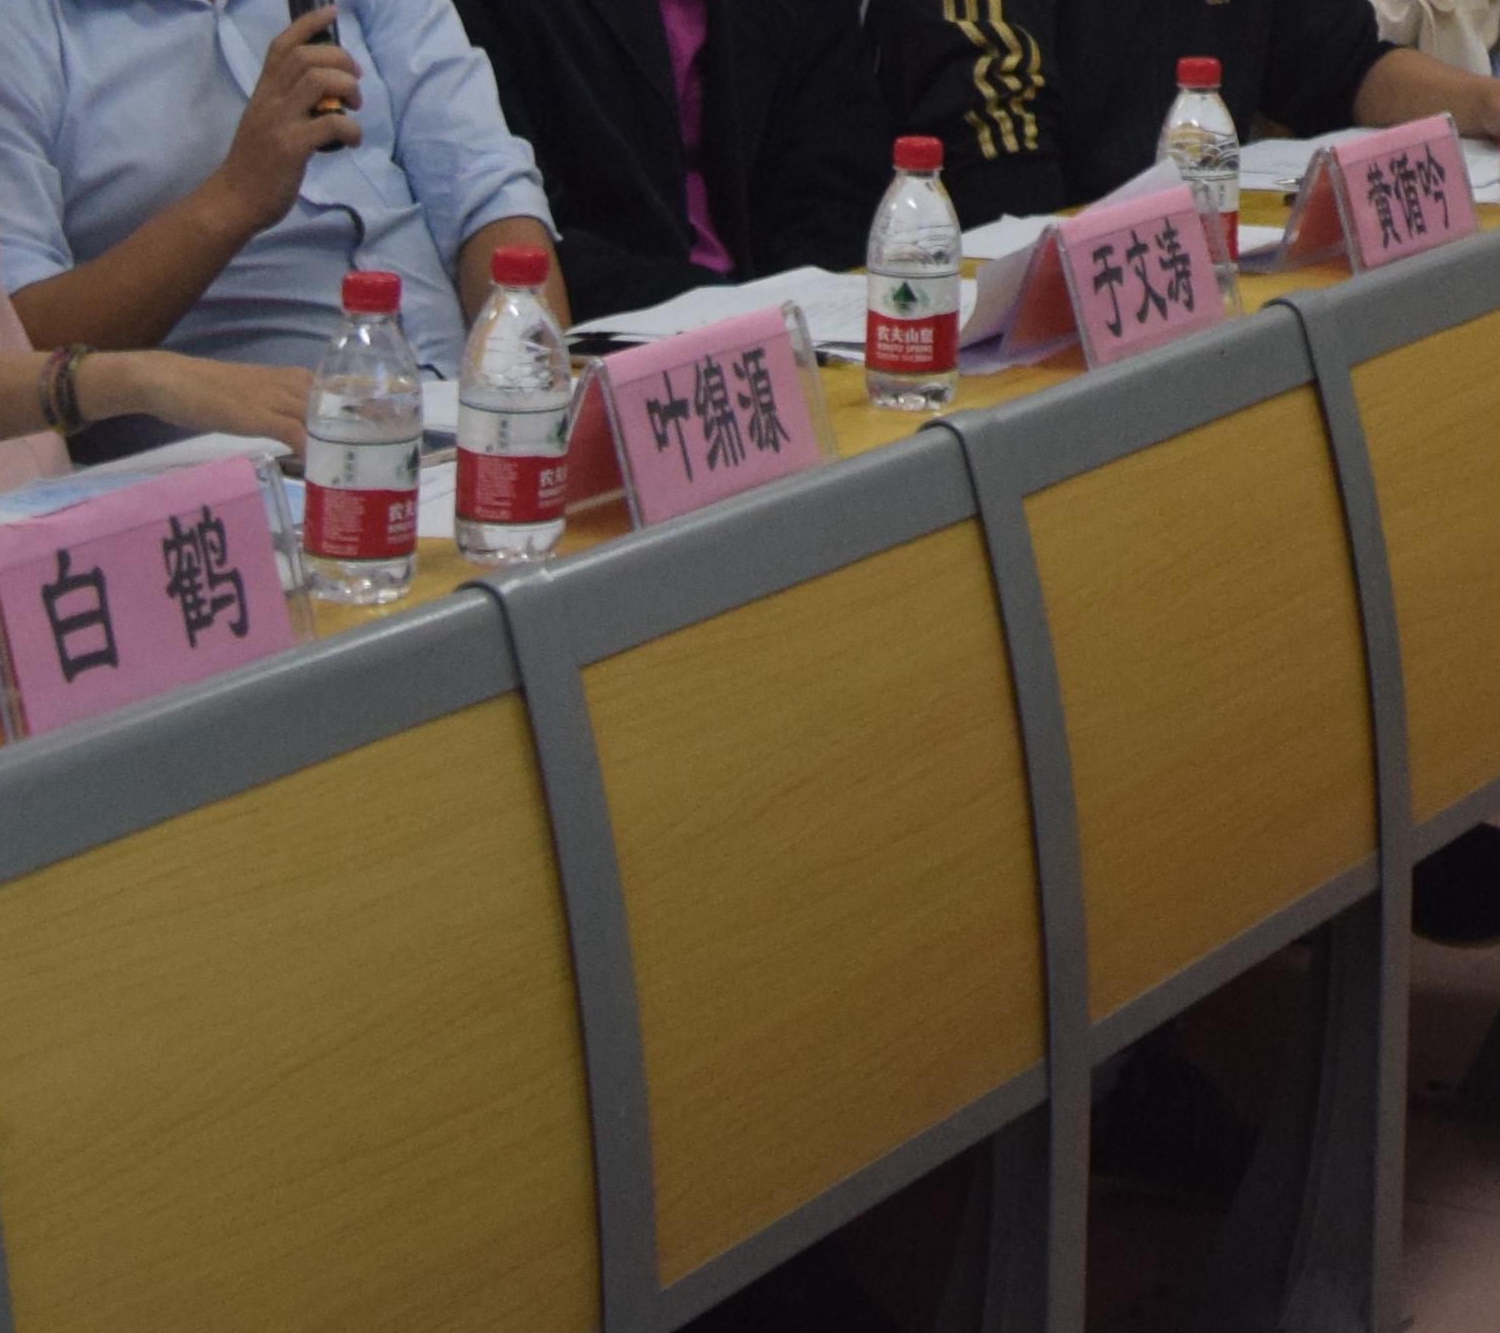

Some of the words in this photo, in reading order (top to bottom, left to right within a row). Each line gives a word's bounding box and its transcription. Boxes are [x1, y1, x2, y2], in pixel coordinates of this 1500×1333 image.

[1367, 141, 1450, 249] 黄循吟
[1092, 217, 1195, 338] 于文涛
[645, 346, 791, 484] 叶绵源
[41, 505, 250, 684] 白鹤
